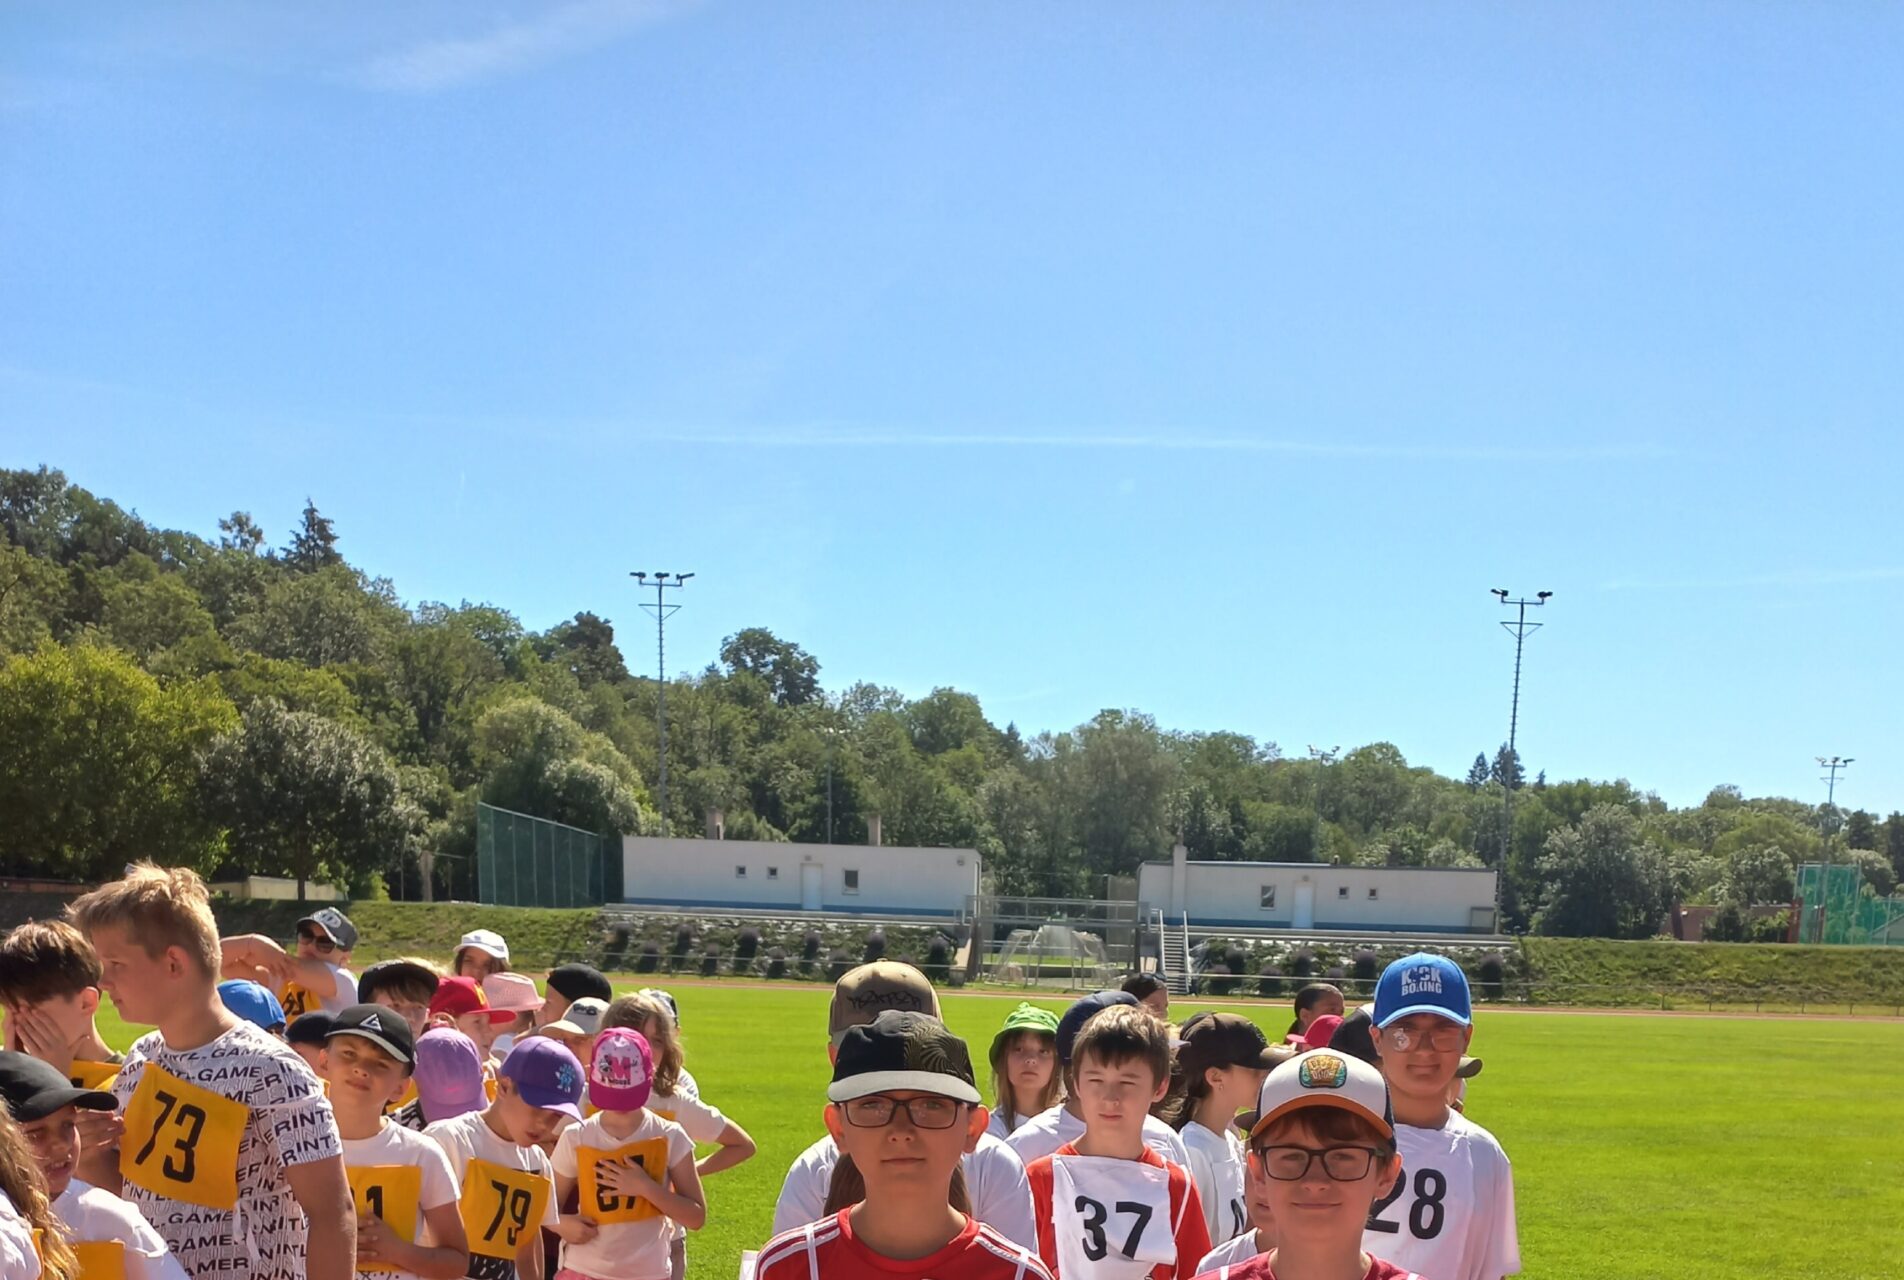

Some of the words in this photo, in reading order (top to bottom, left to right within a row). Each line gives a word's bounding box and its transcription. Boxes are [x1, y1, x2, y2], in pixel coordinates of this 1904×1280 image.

[1402, 981, 1442, 997] BOXING
[134, 1089, 207, 1184] 73
[482, 1178, 532, 1247] 79
[1074, 1195, 1153, 1262] 37
[1364, 1167, 1447, 1240] 28
